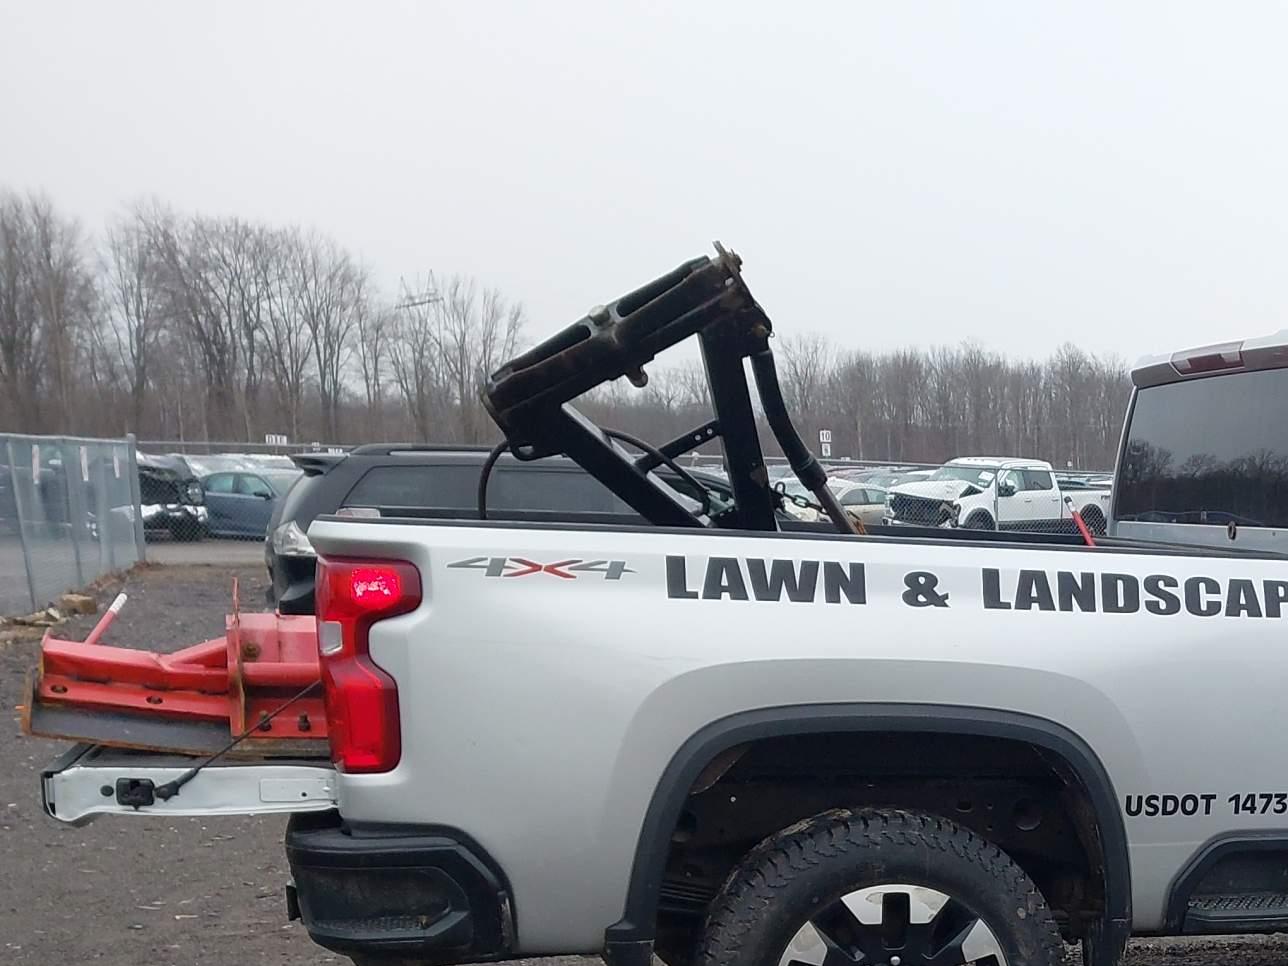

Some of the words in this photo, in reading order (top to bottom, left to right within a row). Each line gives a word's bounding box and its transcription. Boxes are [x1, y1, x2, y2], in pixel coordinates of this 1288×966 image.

[665, 554, 868, 605] LAWN
[901, 570, 951, 609] &
[1125, 793, 1217, 817] USDOT
